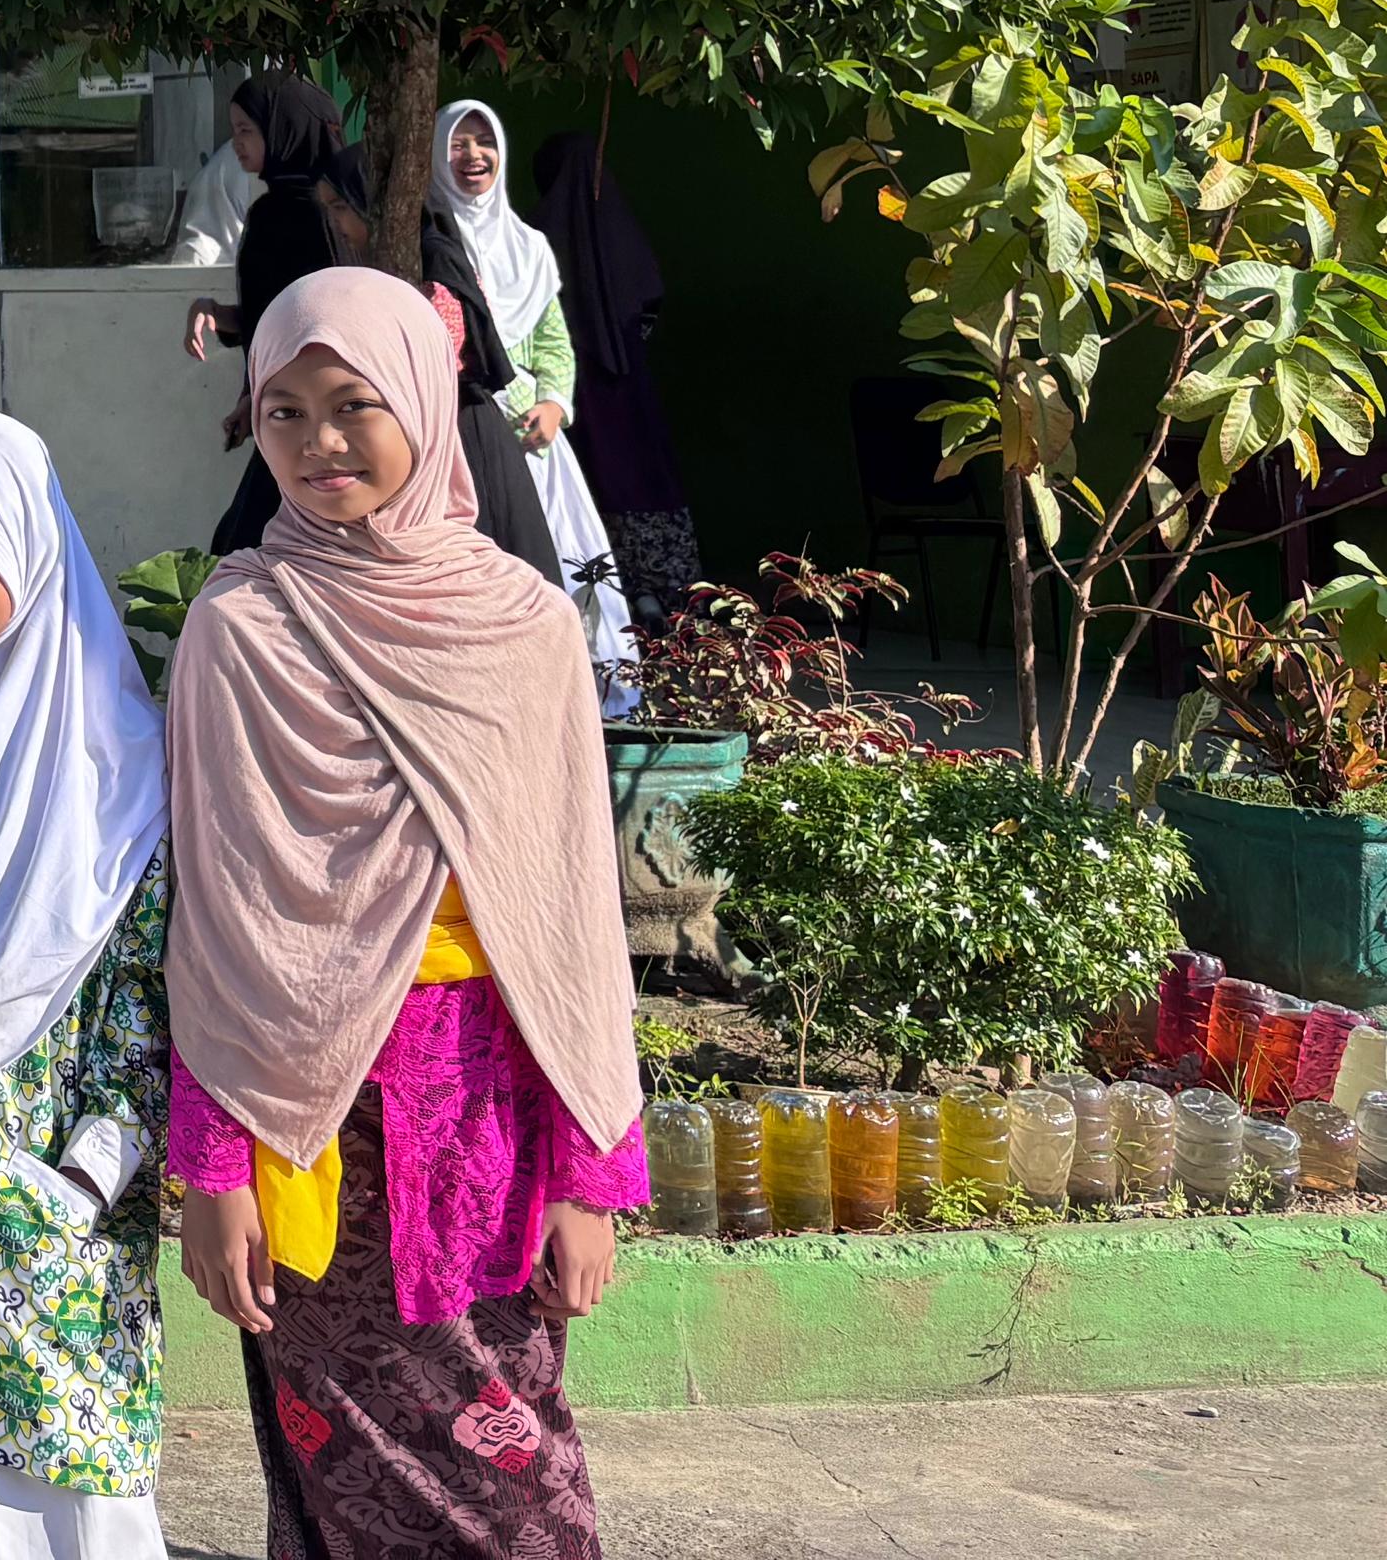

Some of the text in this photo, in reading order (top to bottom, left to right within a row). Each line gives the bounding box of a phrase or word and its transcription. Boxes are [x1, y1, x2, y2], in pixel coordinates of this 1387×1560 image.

[1130, 70, 1160, 86] SAPA
[1, 1226, 25, 1241] DDI
[71, 1329, 93, 1342] DDI
[4, 1392, 26, 1408] DDI
